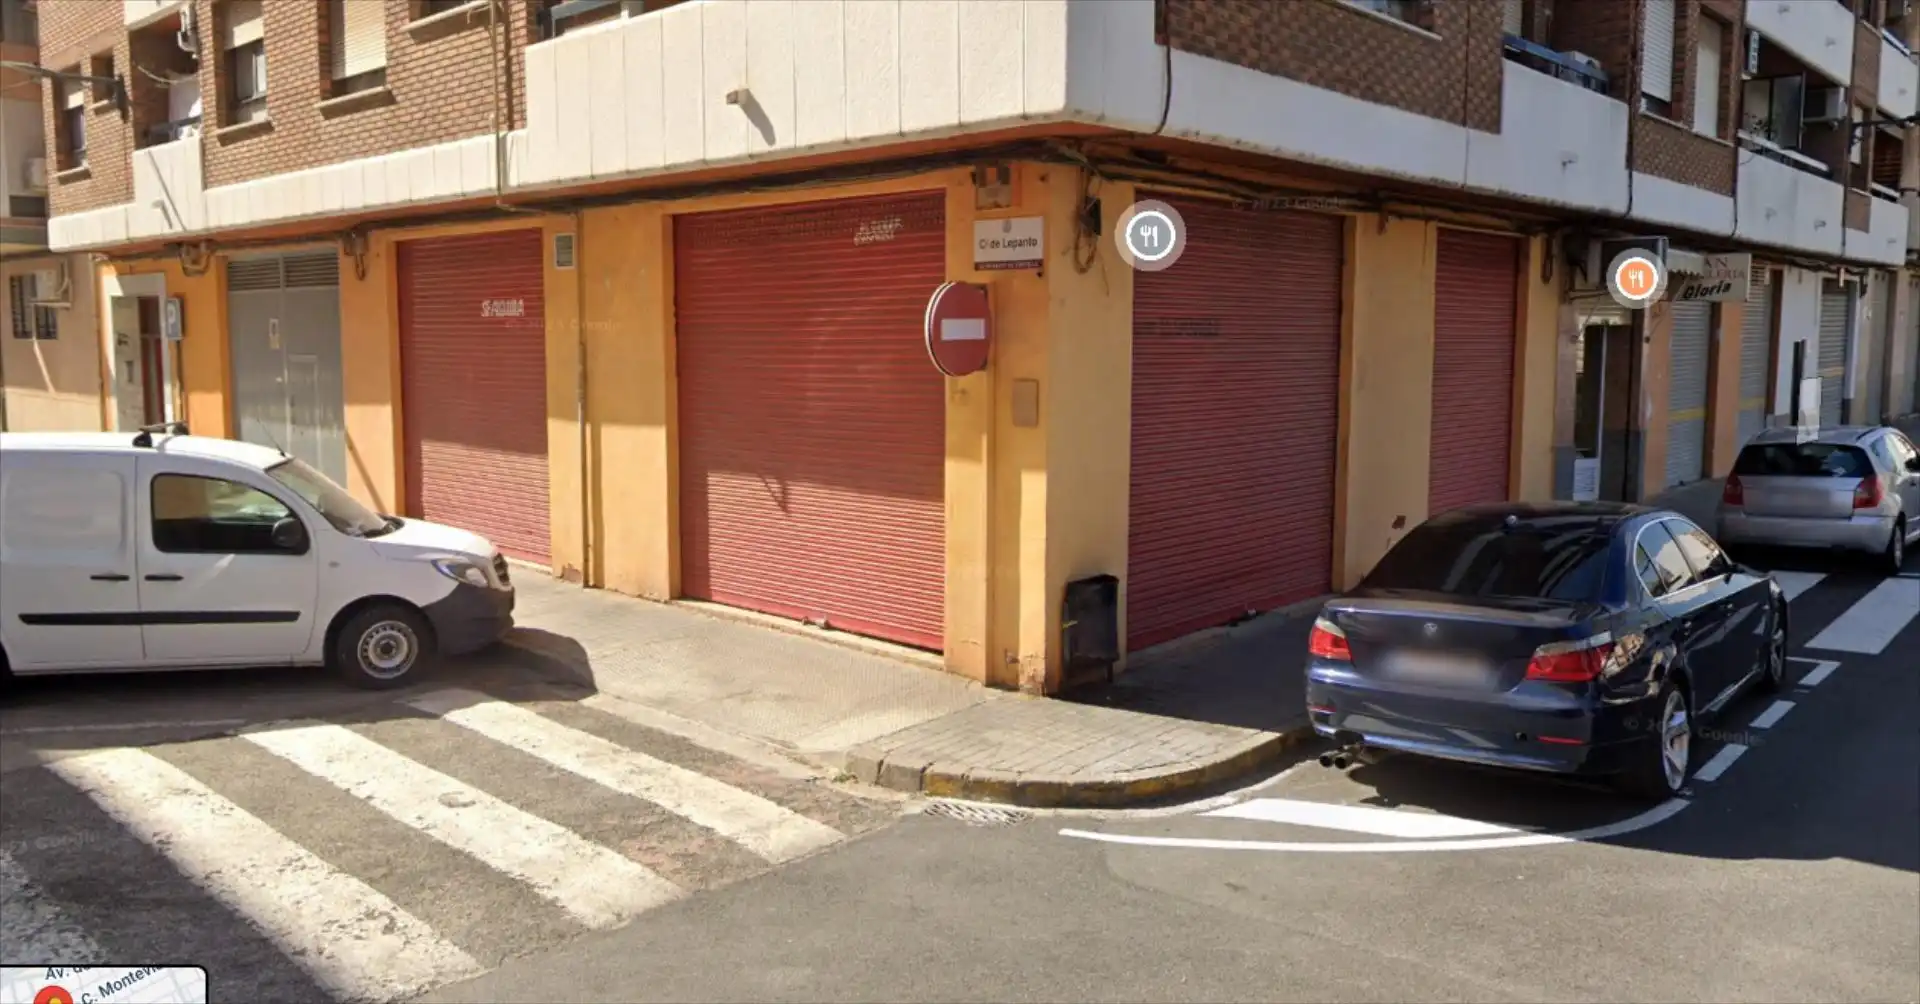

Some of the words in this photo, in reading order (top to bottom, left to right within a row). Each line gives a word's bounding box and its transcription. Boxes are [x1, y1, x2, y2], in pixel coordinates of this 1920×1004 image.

[990, 239, 1001, 249] de
[1002, 236, 1039, 252] Lepanto
[1681, 280, 1732, 299] Gloria
[166, 302, 176, 334] P
